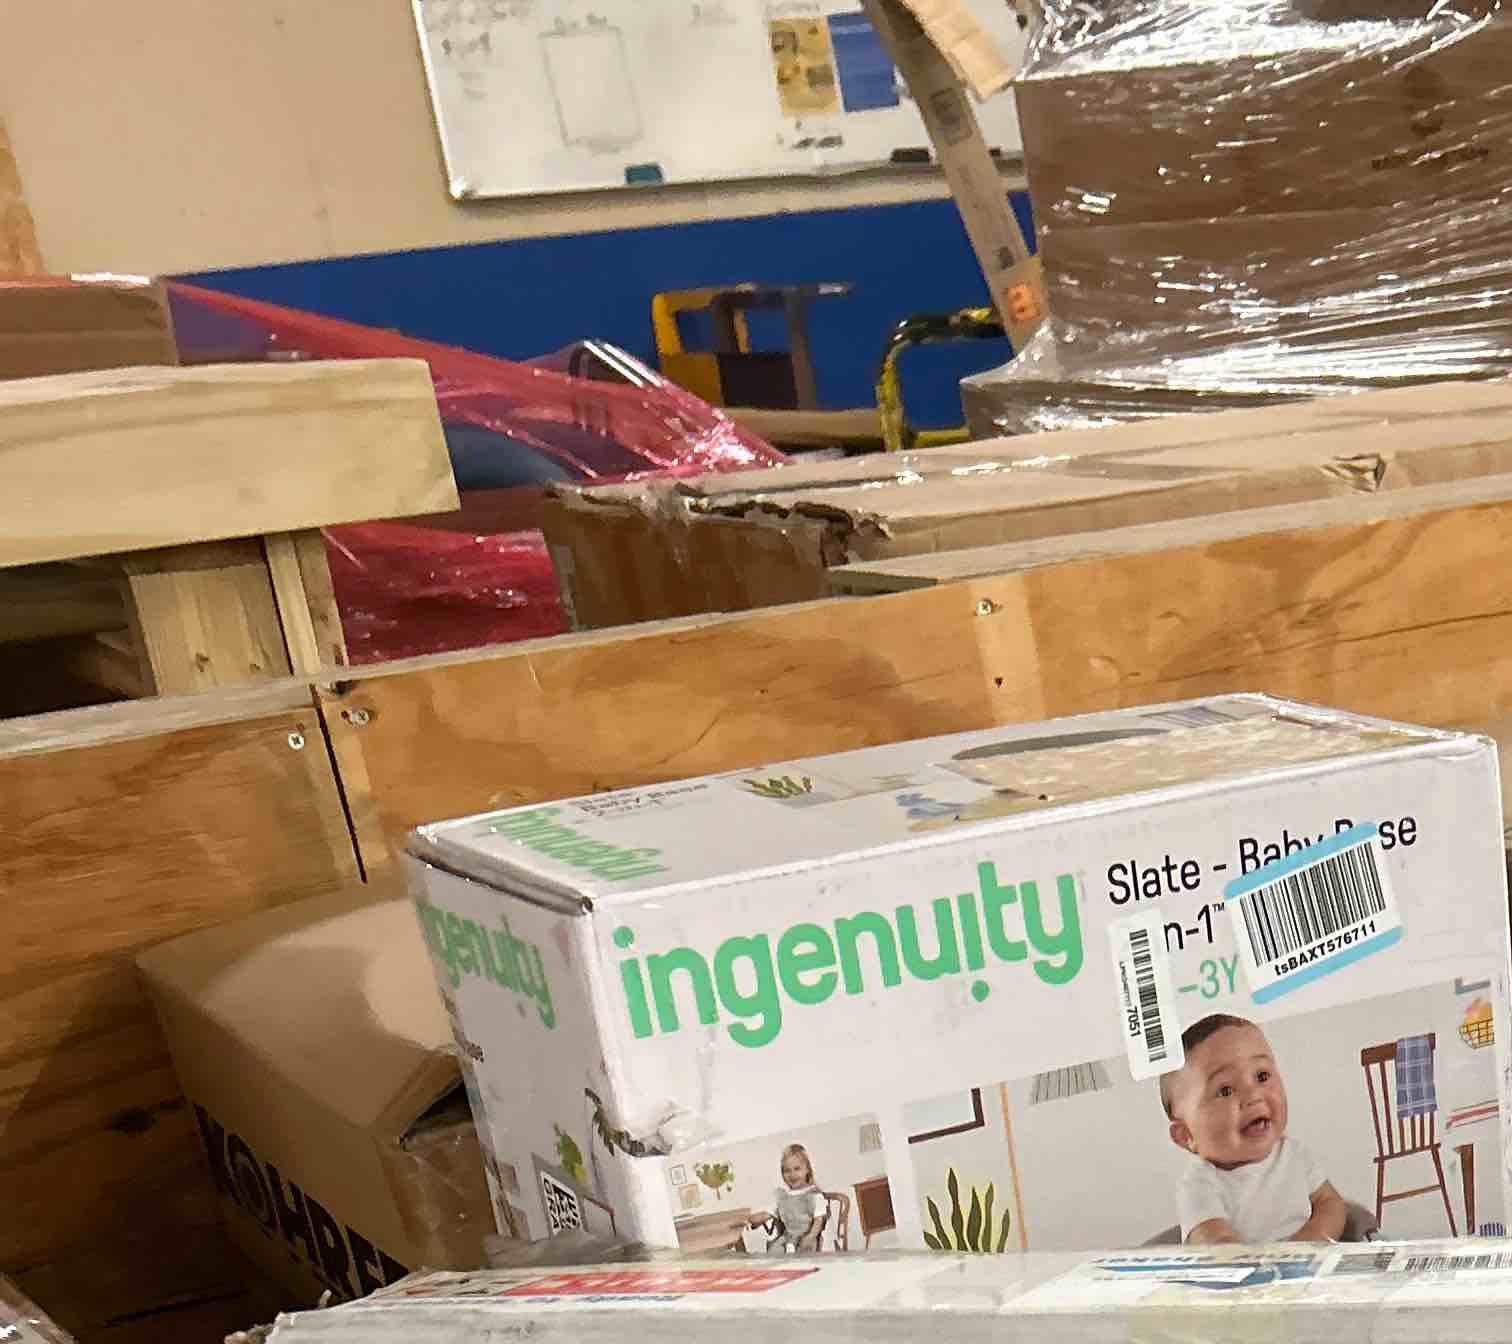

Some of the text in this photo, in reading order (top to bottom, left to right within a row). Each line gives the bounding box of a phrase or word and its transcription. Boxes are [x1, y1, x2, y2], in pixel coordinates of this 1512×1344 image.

[1106, 853, 1202, 905] Slate
[612, 856, 1085, 1048] ingenuity
[1274, 919, 1378, 978] tsBAXT576711
[1126, 1006, 1141, 1038] 7051
